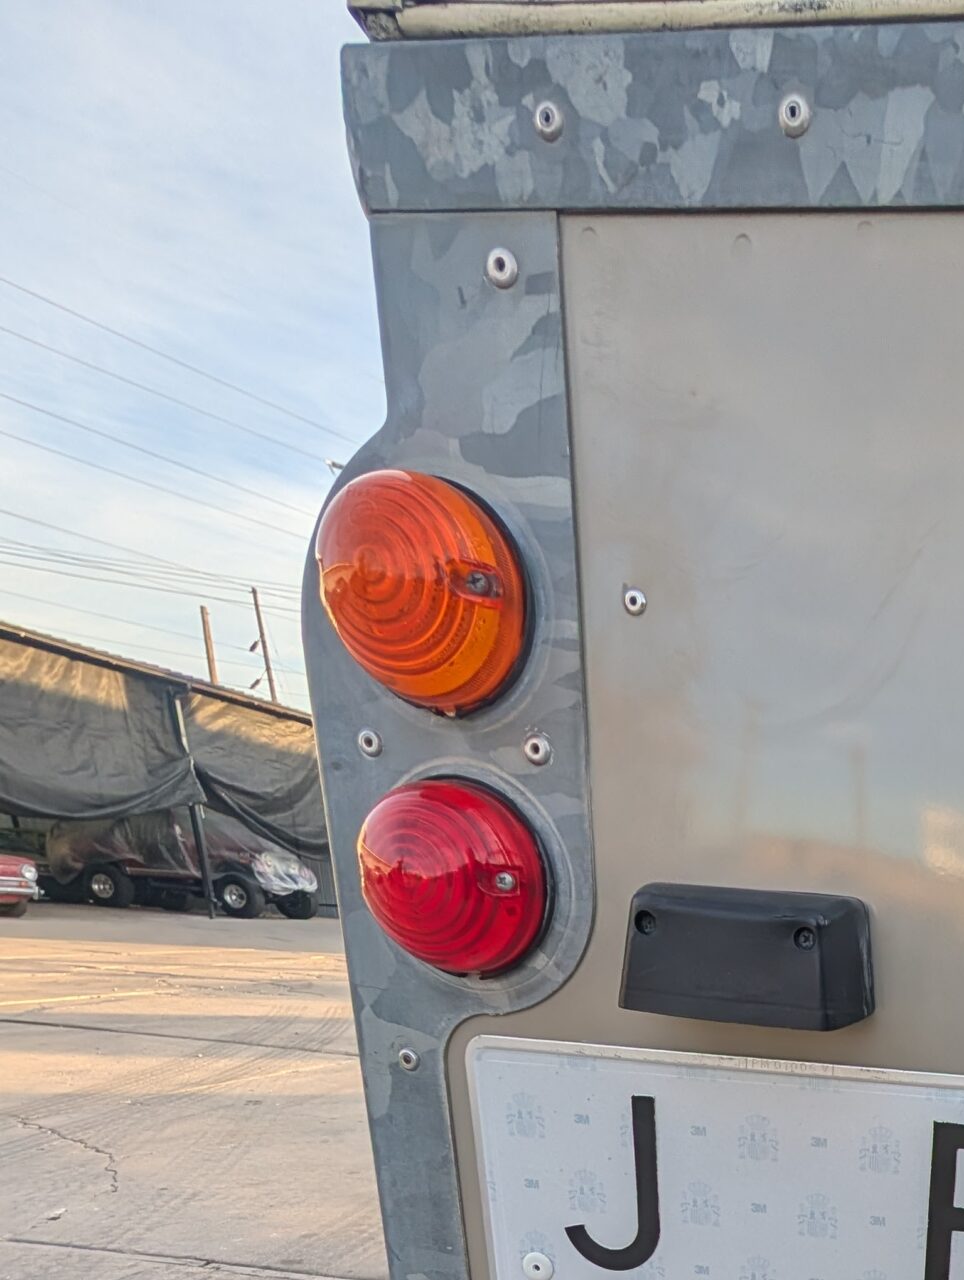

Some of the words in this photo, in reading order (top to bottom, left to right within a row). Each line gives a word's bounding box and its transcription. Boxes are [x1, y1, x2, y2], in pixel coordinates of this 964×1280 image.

[574, 1114, 590, 1125] 3M
[690, 1126, 706, 1136] 3M
[811, 1136, 827, 1148] 3M
[525, 1179, 539, 1189] 3M
[565, 1094, 660, 1270] J
[751, 1203, 767, 1213] 3M
[870, 1216, 886, 1227] 3M
[694, 1265, 709, 1275] 3M
